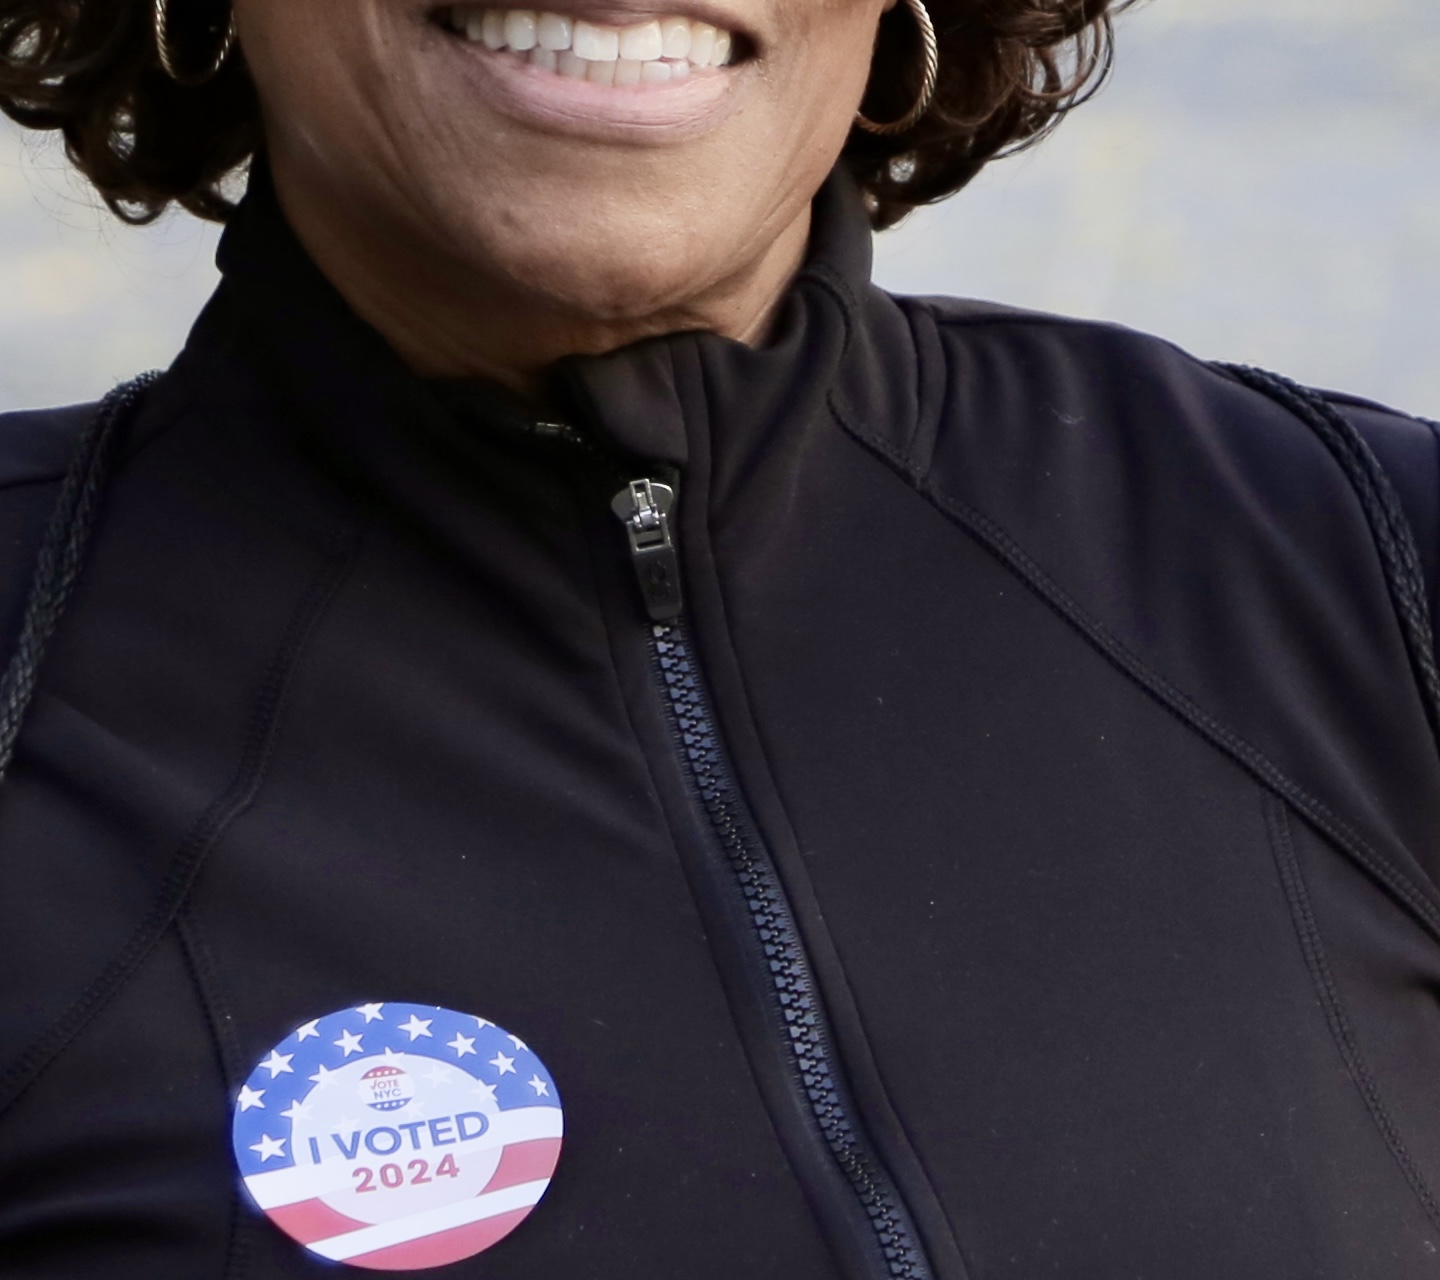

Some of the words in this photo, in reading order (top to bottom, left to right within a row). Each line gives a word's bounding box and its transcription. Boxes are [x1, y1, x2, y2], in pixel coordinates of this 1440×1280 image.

[373, 1088, 402, 1100] NYC
[308, 1136, 321, 1165] I
[330, 1111, 490, 1160] VOTED
[352, 1153, 460, 1193] 2024
